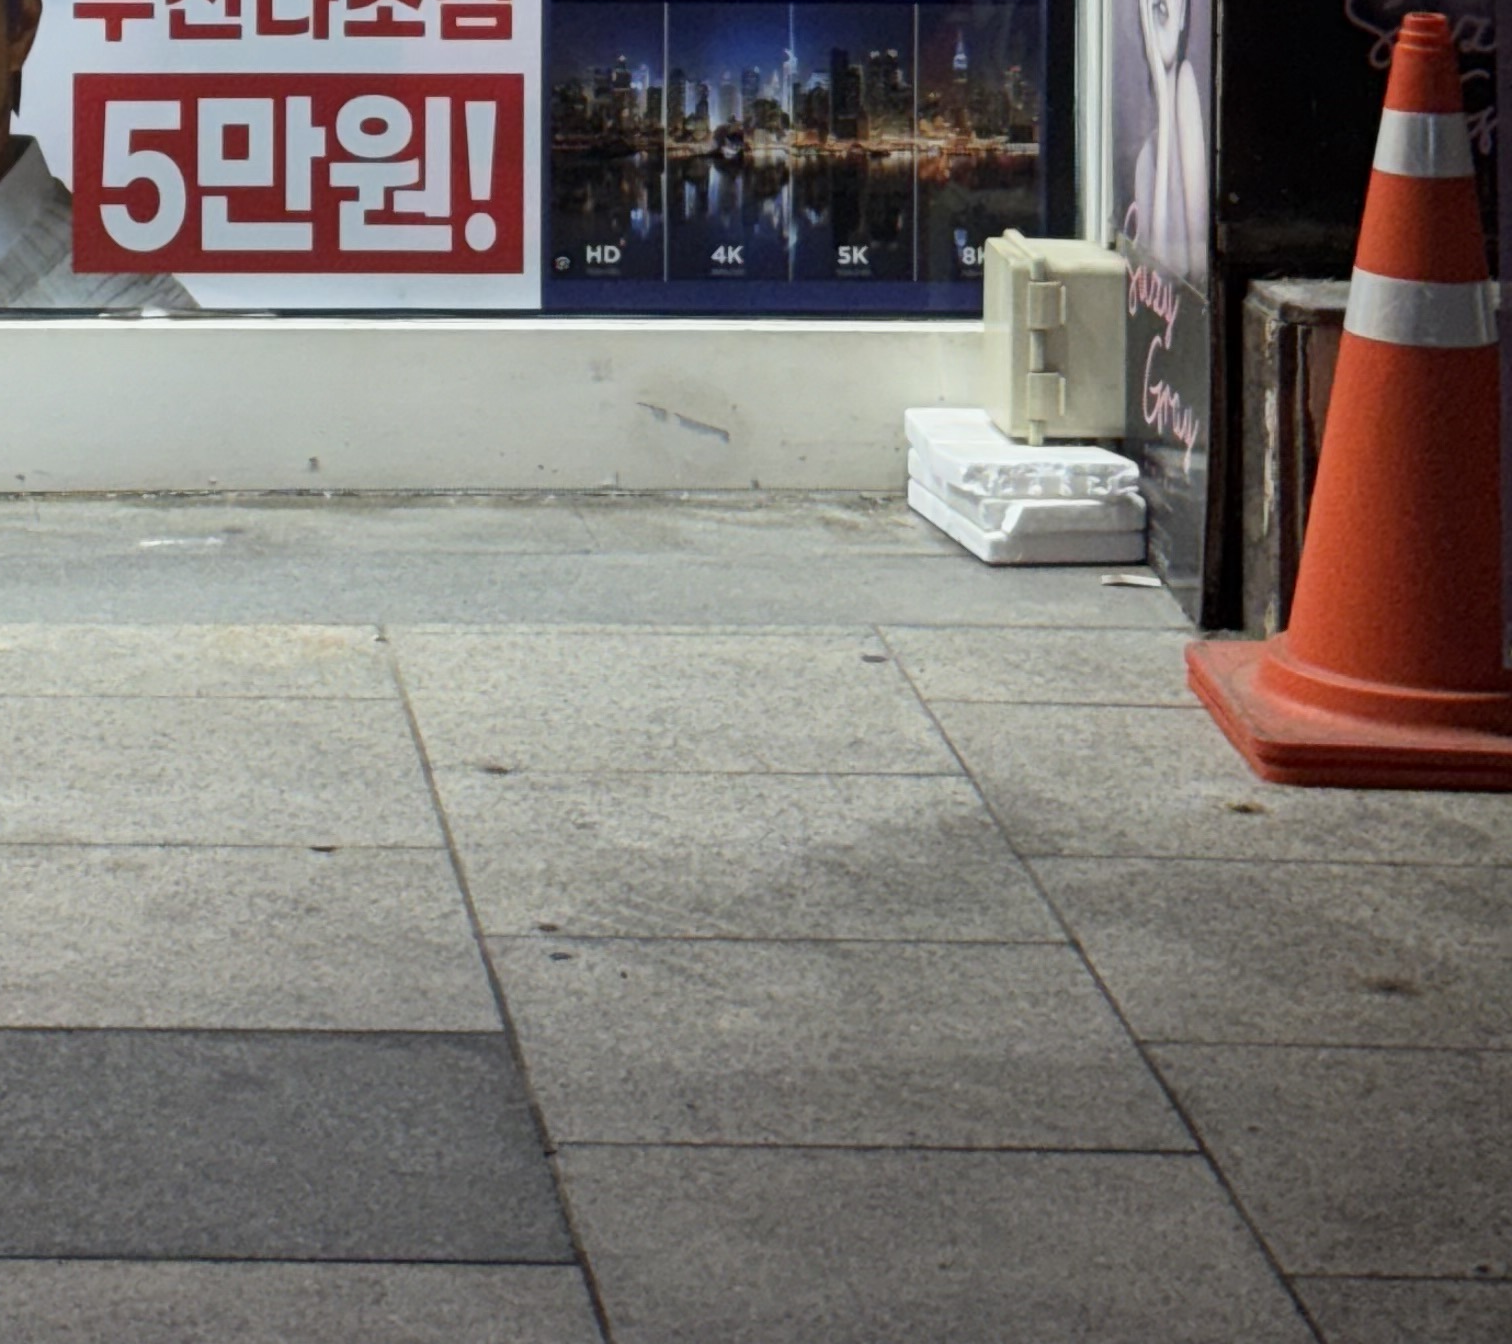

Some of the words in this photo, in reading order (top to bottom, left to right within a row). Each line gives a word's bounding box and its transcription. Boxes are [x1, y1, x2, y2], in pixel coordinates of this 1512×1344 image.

[98, 91, 498, 257] 5만원!
[585, 244, 622, 266] HD
[710, 244, 745, 266] 4K
[837, 244, 871, 266] 5K
